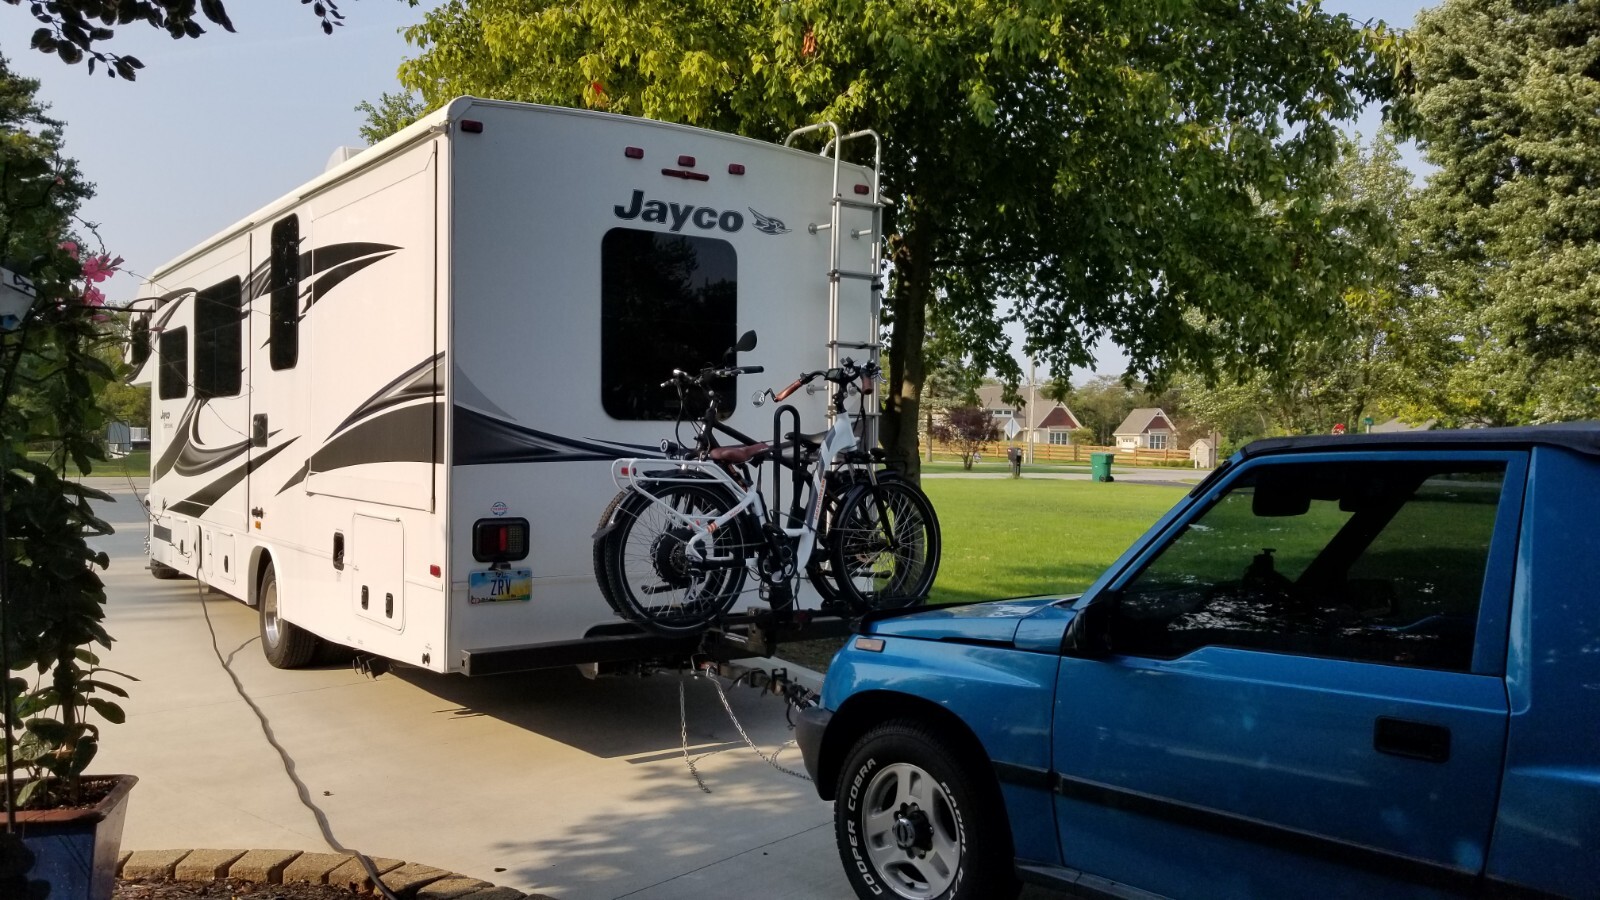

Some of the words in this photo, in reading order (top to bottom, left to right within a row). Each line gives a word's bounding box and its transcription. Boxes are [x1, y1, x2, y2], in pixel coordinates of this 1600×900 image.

[614, 188, 744, 232] Jayco
[491, 578, 511, 596] ZRV
[848, 758, 876, 811] COBRA
[847, 820, 882, 895] COOPER
